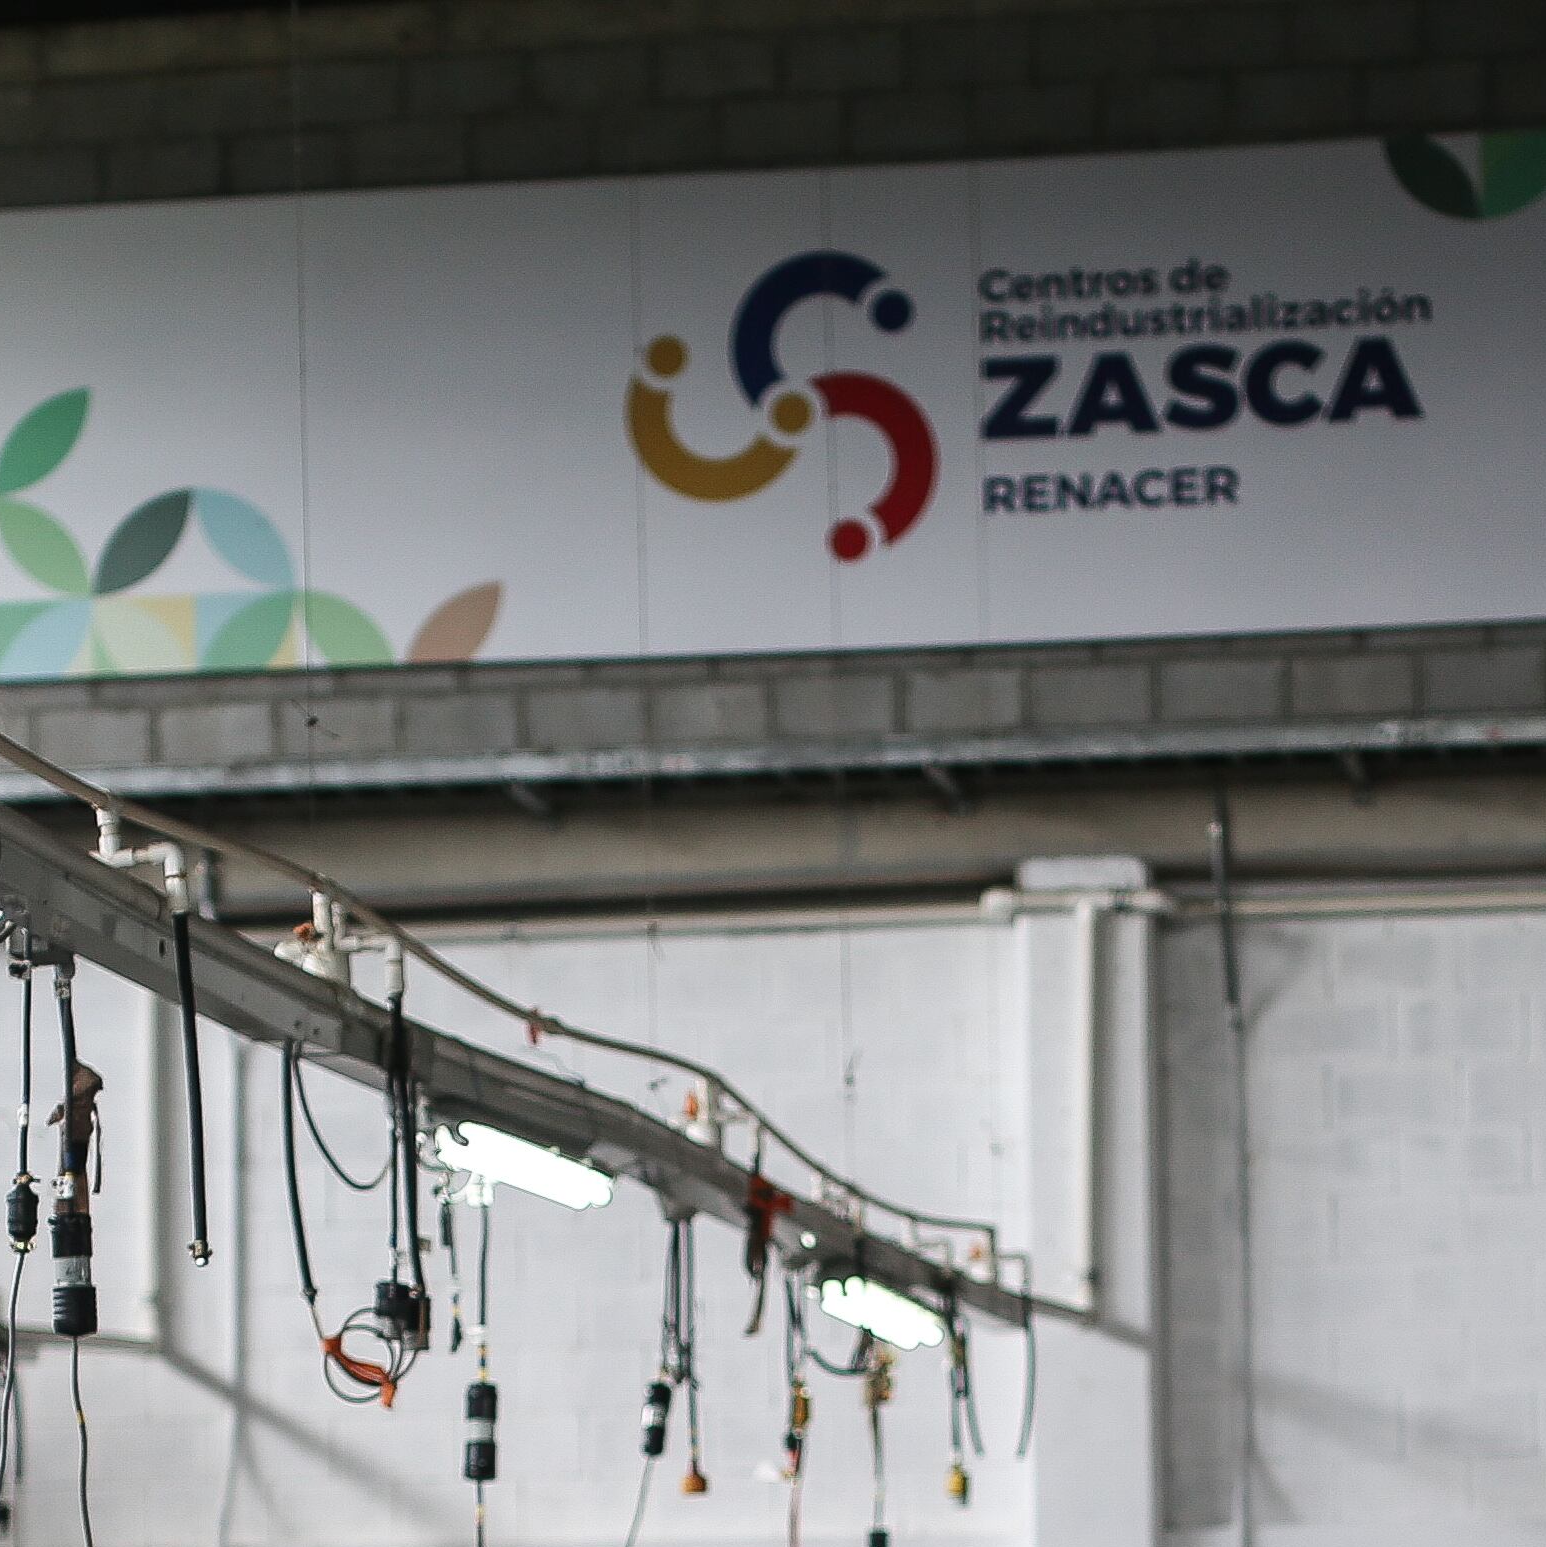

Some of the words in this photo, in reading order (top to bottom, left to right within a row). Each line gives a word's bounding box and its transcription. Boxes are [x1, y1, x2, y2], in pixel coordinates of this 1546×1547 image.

[979, 264, 1159, 302] Centros
[1169, 258, 1229, 295] de
[979, 287, 1433, 344] Reindustrialización
[979, 336, 1426, 441] ZASCA
[982, 465, 1241, 515] RENACER
